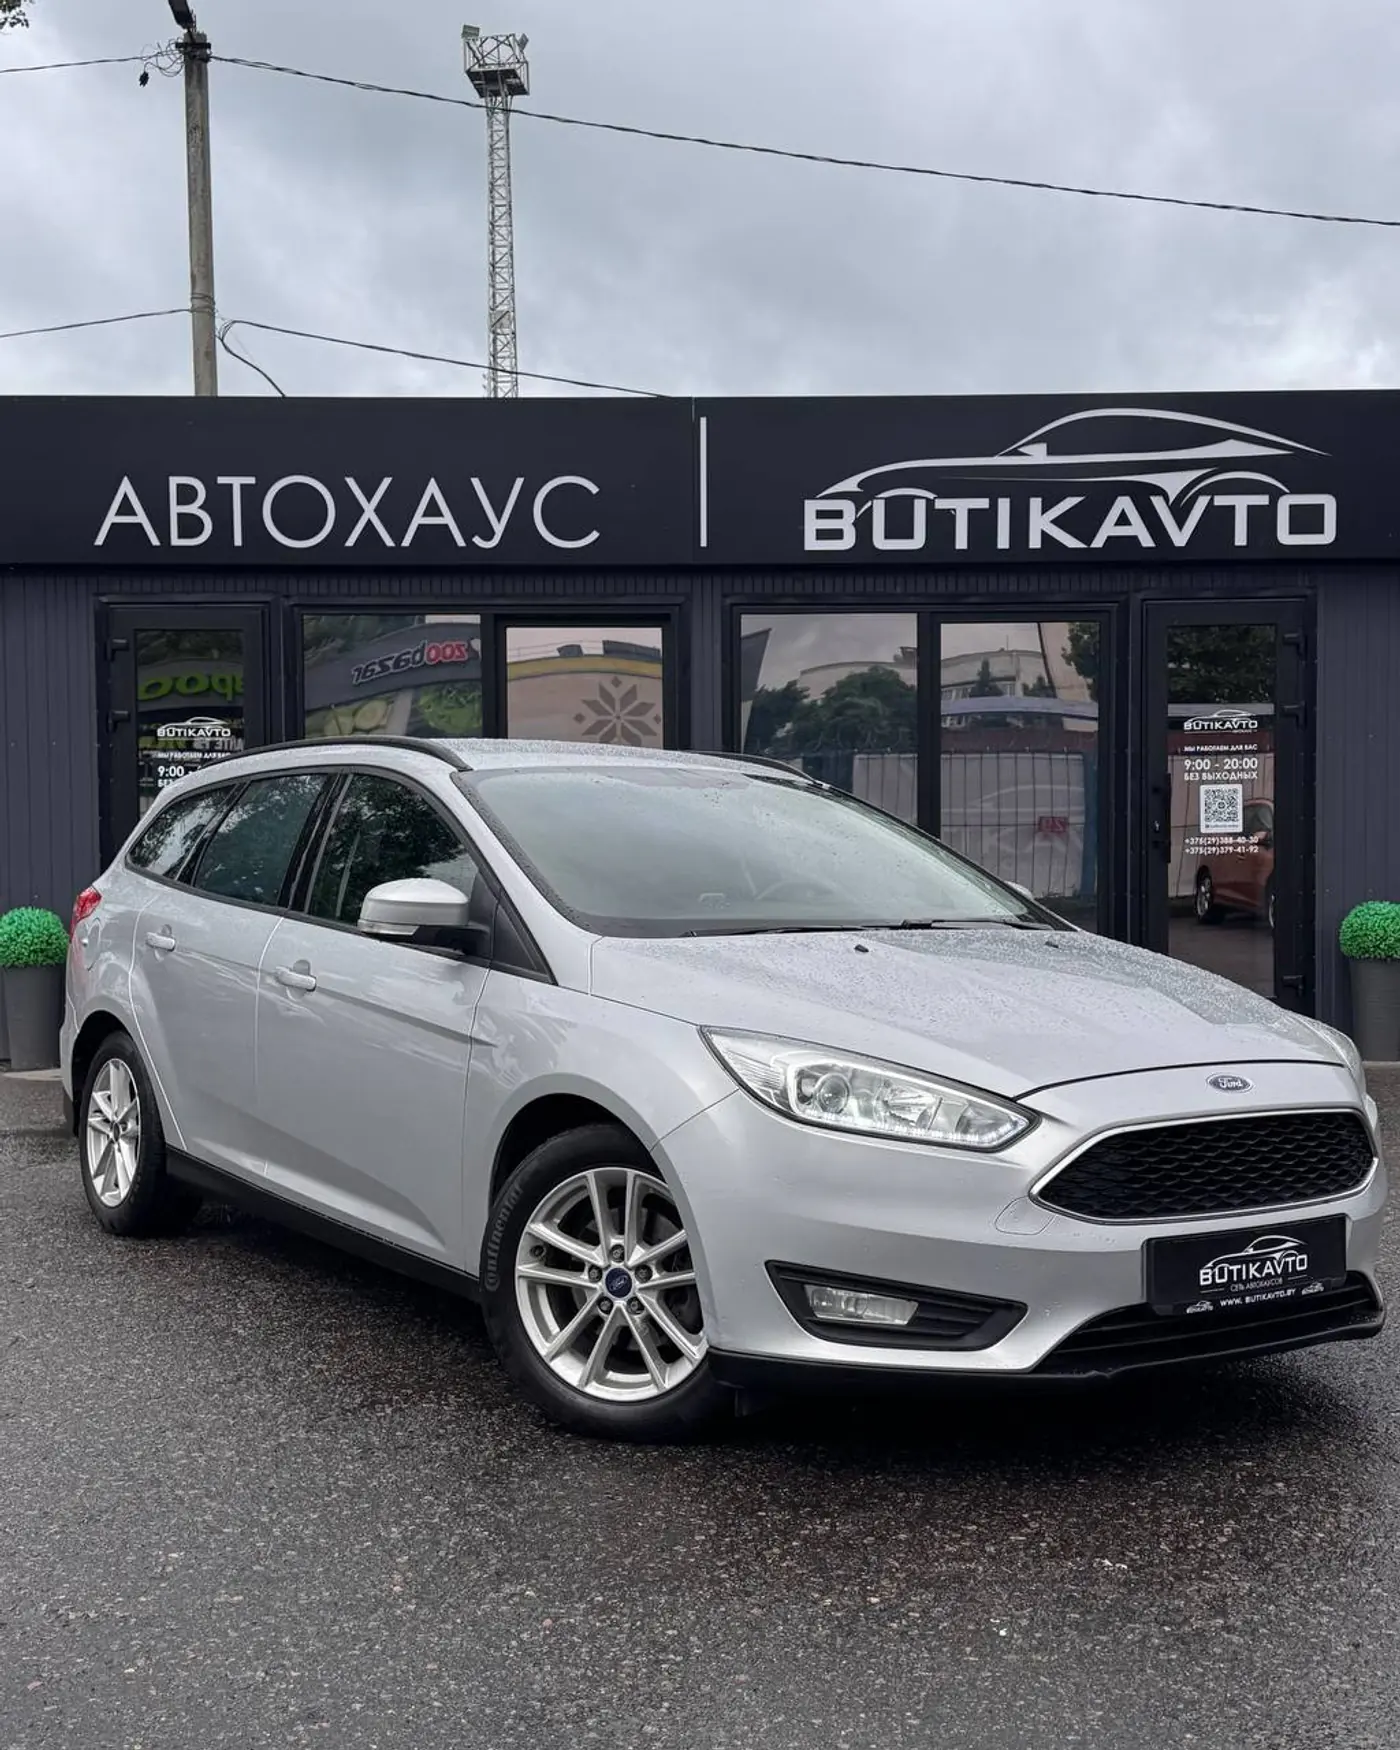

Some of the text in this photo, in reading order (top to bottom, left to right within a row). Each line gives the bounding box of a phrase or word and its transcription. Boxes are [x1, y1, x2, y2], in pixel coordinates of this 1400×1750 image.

[94, 475, 600, 549] АВТОХАУС
[803, 493, 1337, 551] BUTIKAVTO
[1184, 721, 1258, 730] BUTIKAVTO
[157, 728, 231, 737] BUTIKAVTO
[1184, 758, 1211, 771] 9:00
[1223, 757, 1258, 770] 20:00
[157, 765, 184, 777] 9:00
[1184, 771, 1258, 781] БЕЗ ВЫХОДНЫХ
[1218, 1077, 1243, 1089] Ford
[1200, 1255, 1308, 1285] BUTIKAVTO
[1245, 1288, 1296, 1302] BUTIKAVTO.BY
